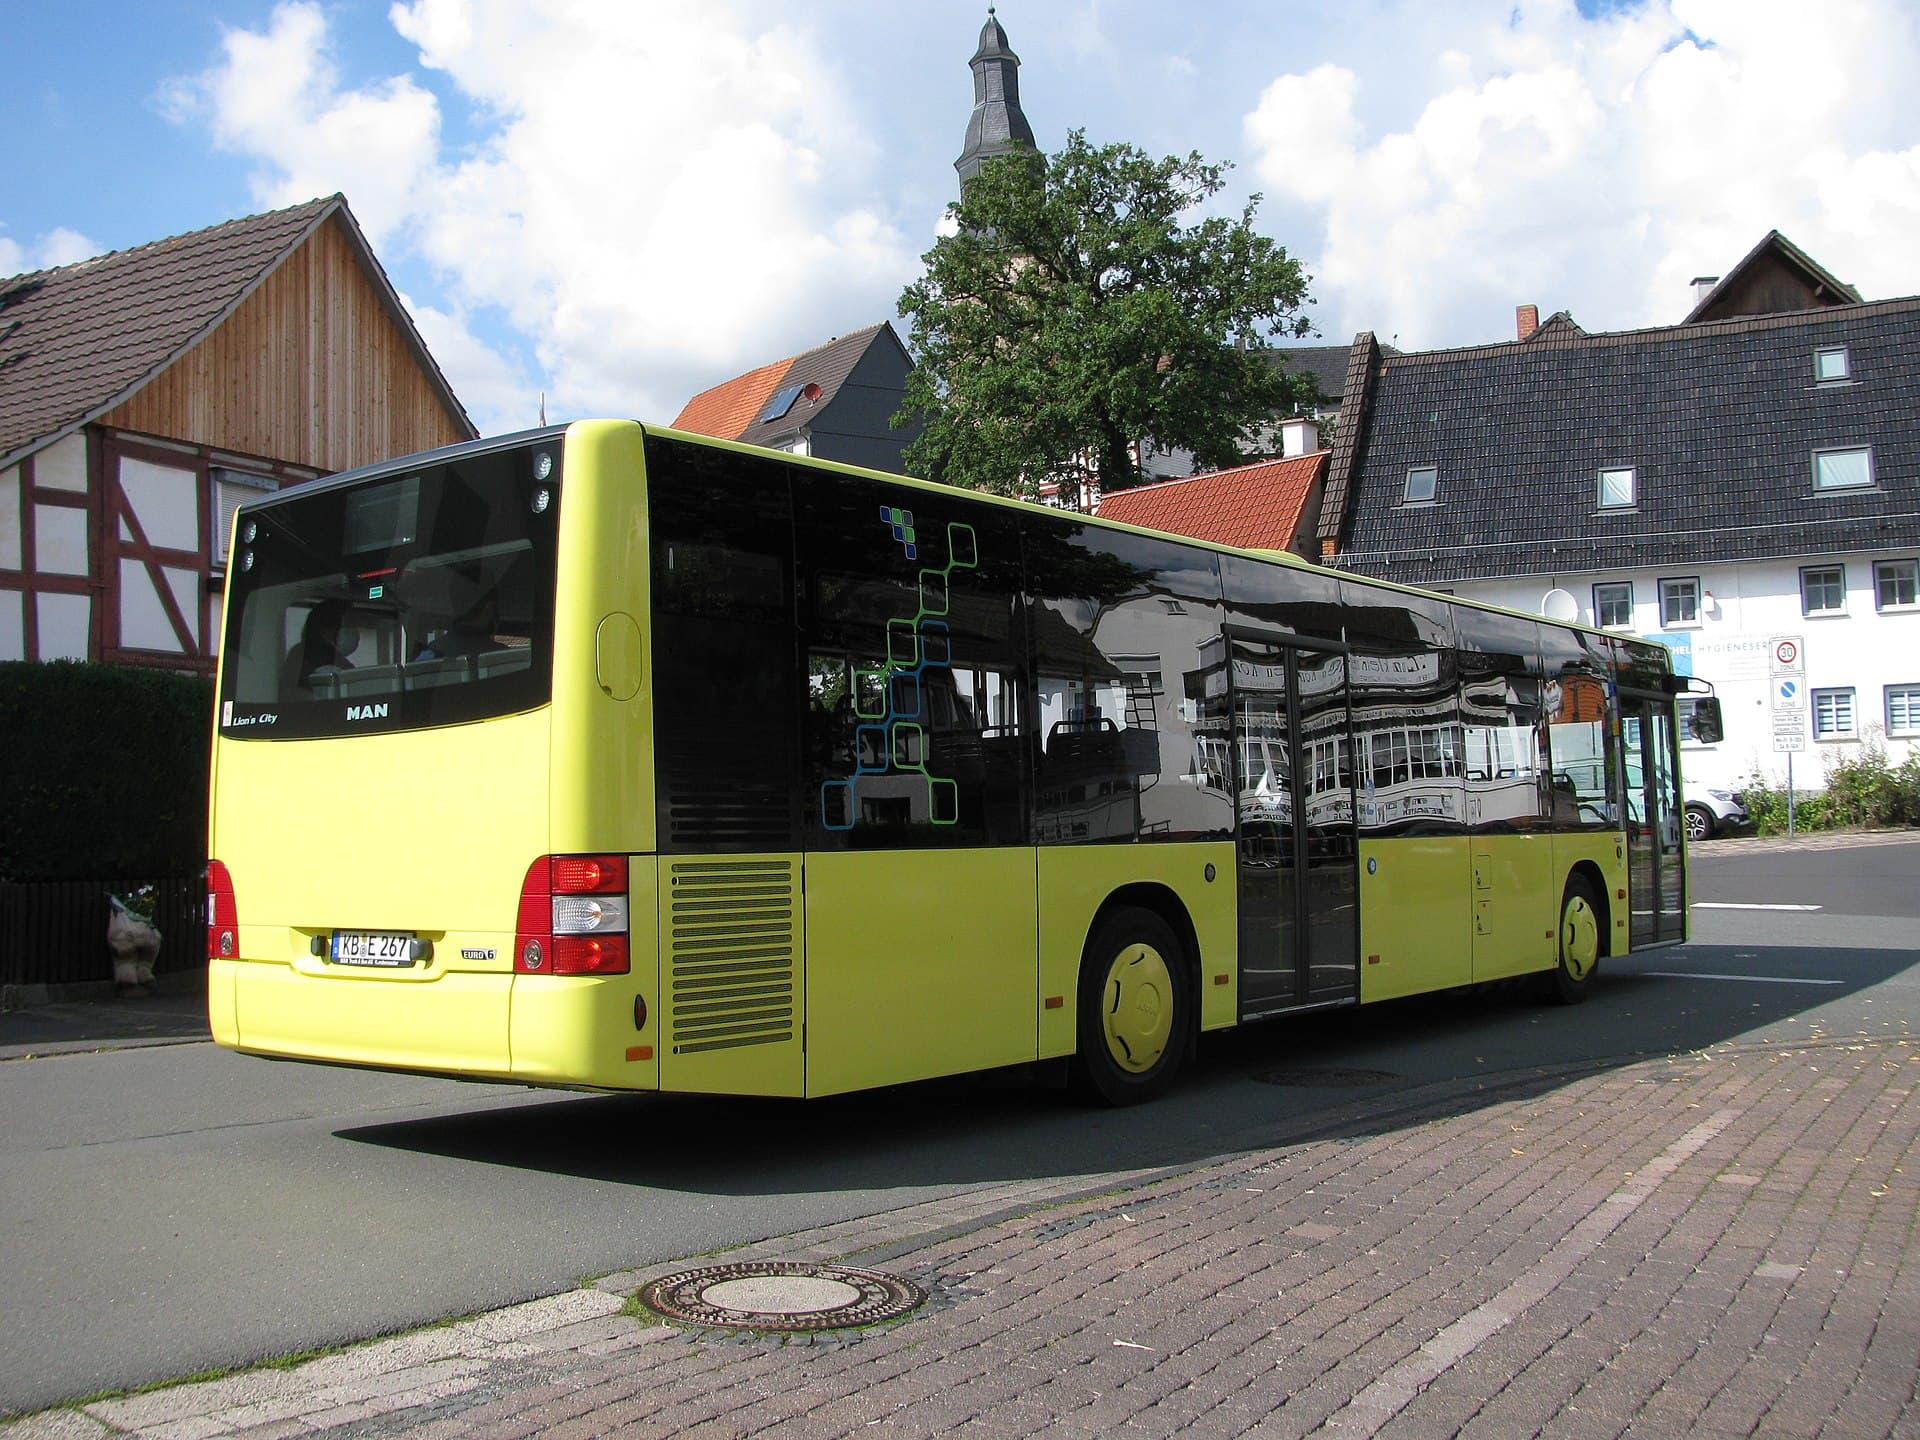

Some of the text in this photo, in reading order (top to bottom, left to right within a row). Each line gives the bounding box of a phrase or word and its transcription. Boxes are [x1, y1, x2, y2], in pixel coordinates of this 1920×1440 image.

[1780, 647, 1793, 657] 30
[347, 703, 388, 720] MAN
[233, 713, 278, 726] Lion's City
[343, 934, 407, 958] KB E 267
[463, 949, 495, 960] EURO 6
